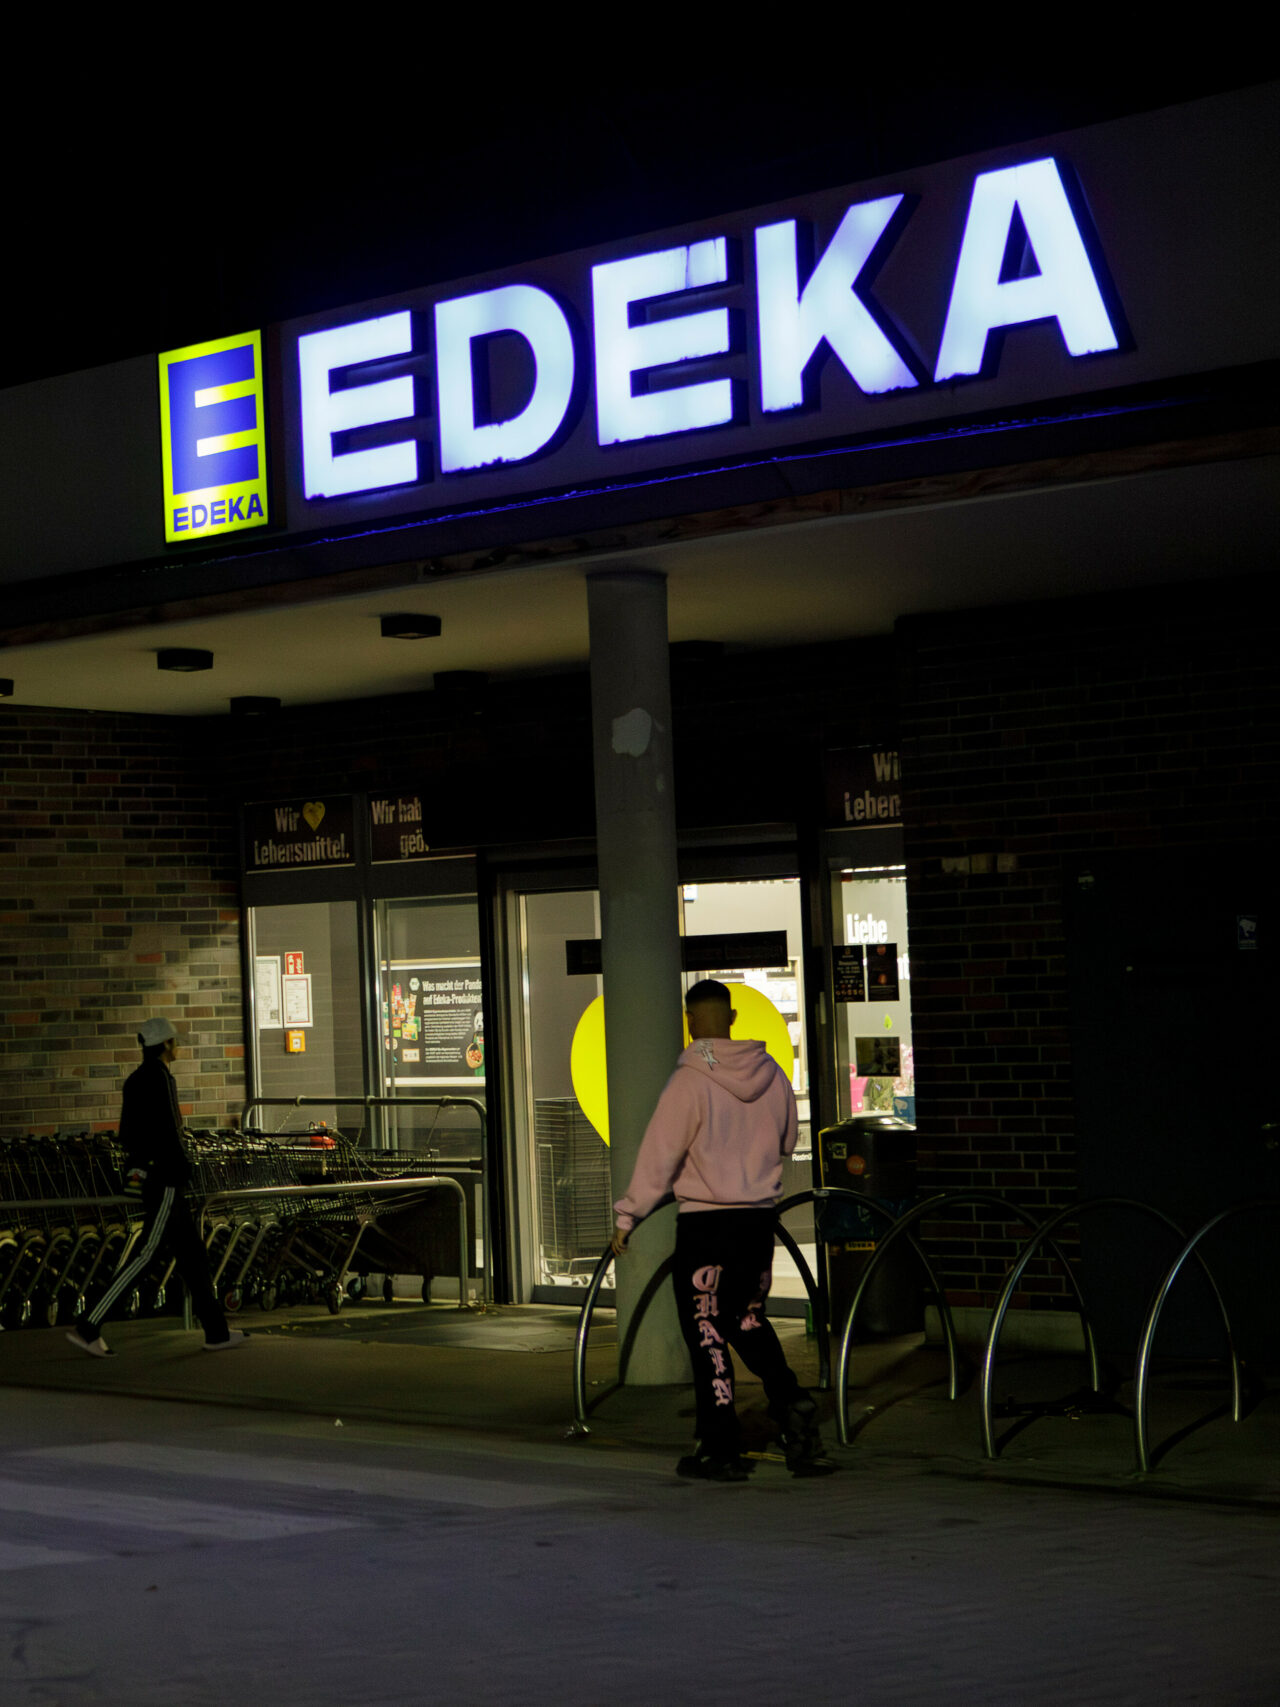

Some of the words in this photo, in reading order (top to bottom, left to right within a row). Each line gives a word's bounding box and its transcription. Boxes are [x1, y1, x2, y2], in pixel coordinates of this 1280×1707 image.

[297, 156, 1122, 502] EDEKA
[173, 493, 264, 533] EDEKA
[872, 751, 902, 782] Wi
[274, 806, 300, 832] Wir
[370, 799, 396, 826] Wir
[254, 832, 351, 866] Lebensmittel.
[400, 828, 430, 859] geö
[846, 912, 888, 945] Liebe
